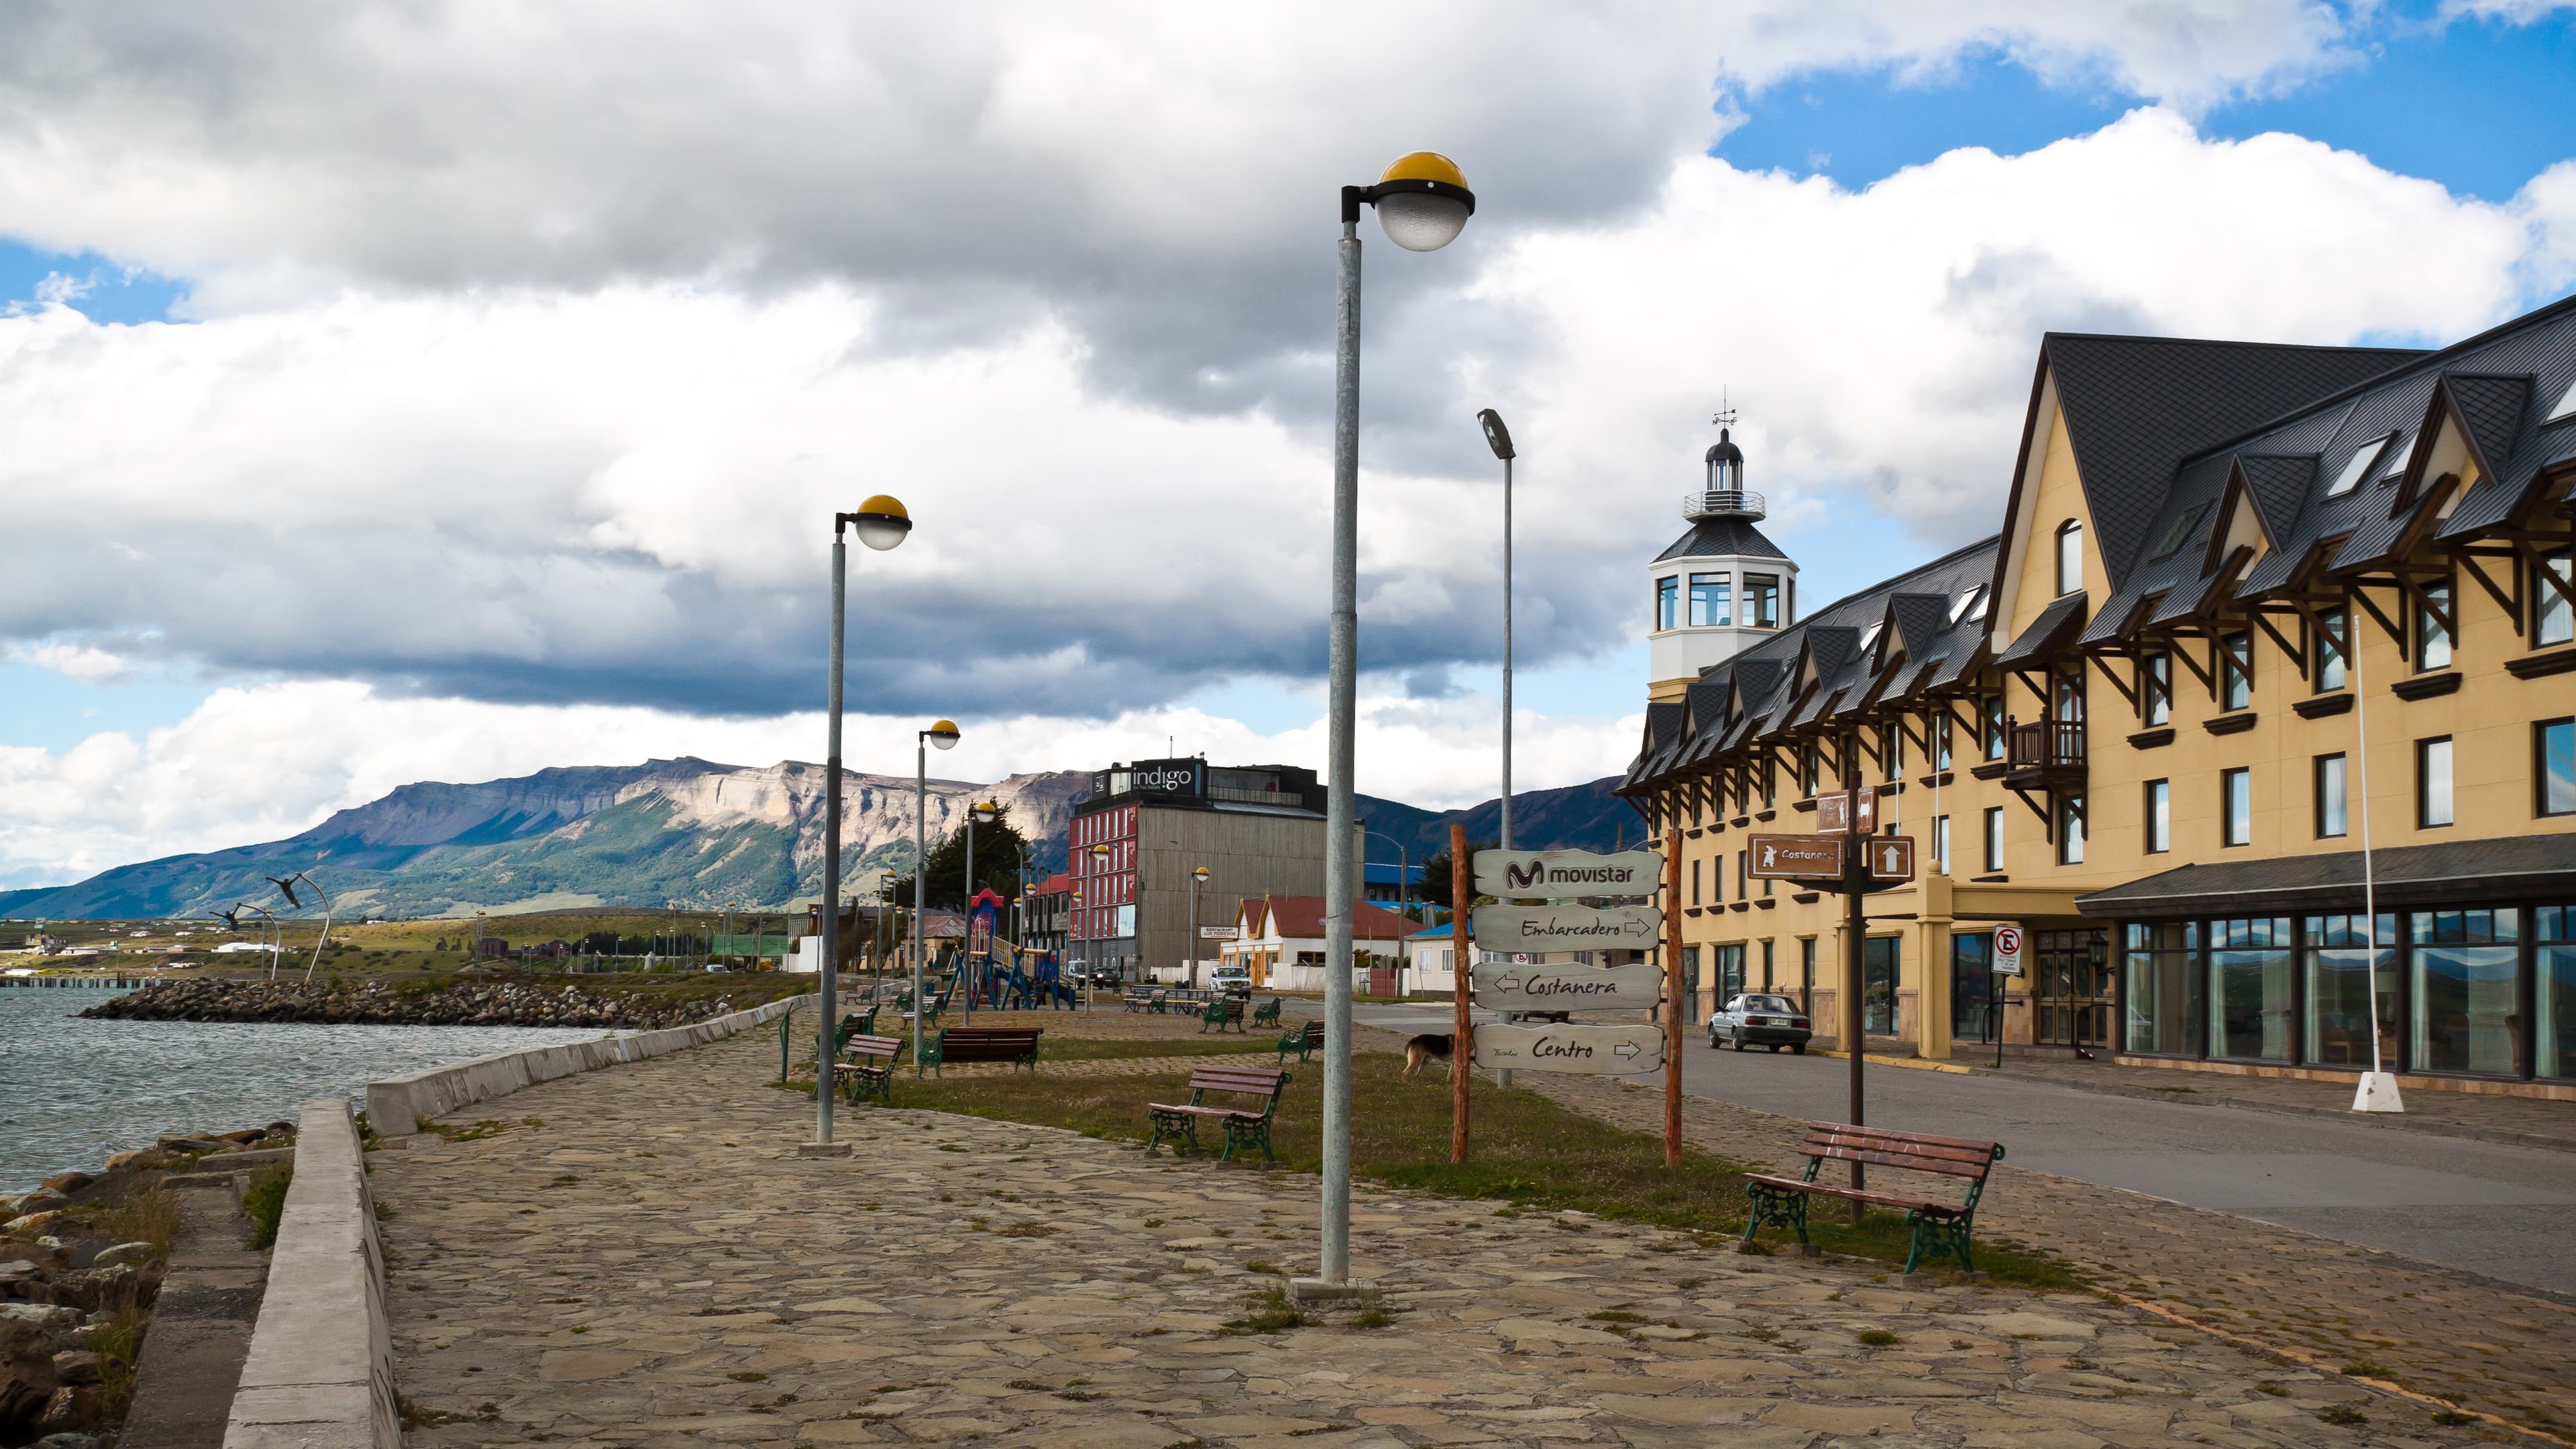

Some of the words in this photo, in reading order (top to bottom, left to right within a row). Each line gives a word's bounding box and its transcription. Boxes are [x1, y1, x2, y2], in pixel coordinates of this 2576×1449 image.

[1133, 766, 1191, 790] indigo
[1550, 866, 1633, 883] movistar
[1521, 916, 1620, 937] Embarcadero
[1525, 975, 1618, 996] Costanera
[1532, 1036, 1593, 1058] Centro
